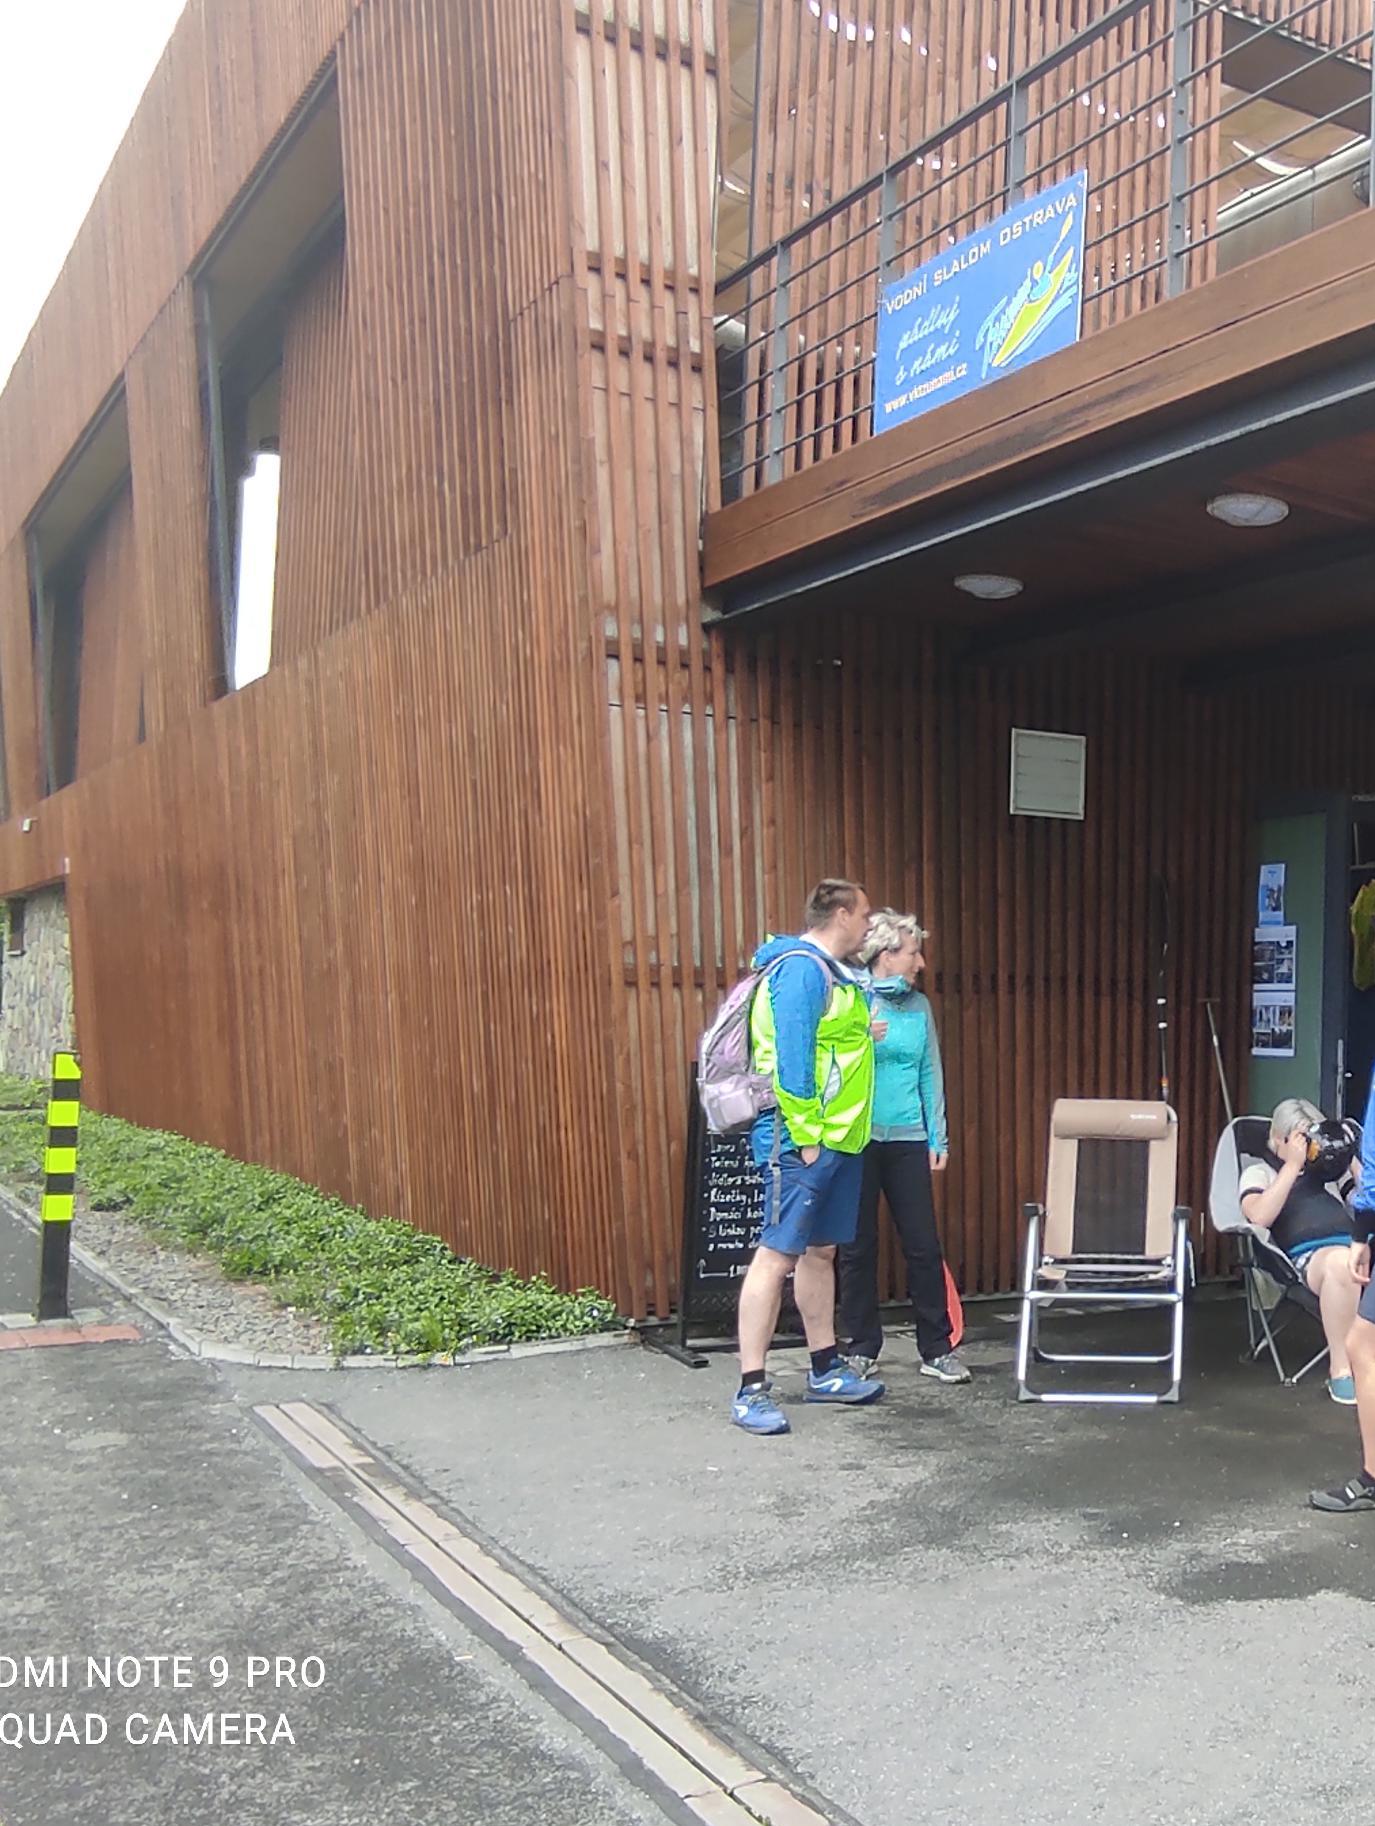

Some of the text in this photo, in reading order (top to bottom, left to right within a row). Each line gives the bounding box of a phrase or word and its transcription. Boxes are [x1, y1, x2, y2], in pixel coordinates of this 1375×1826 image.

[885, 193, 1077, 315] VODNÍ SLALOM OSTRAVA
